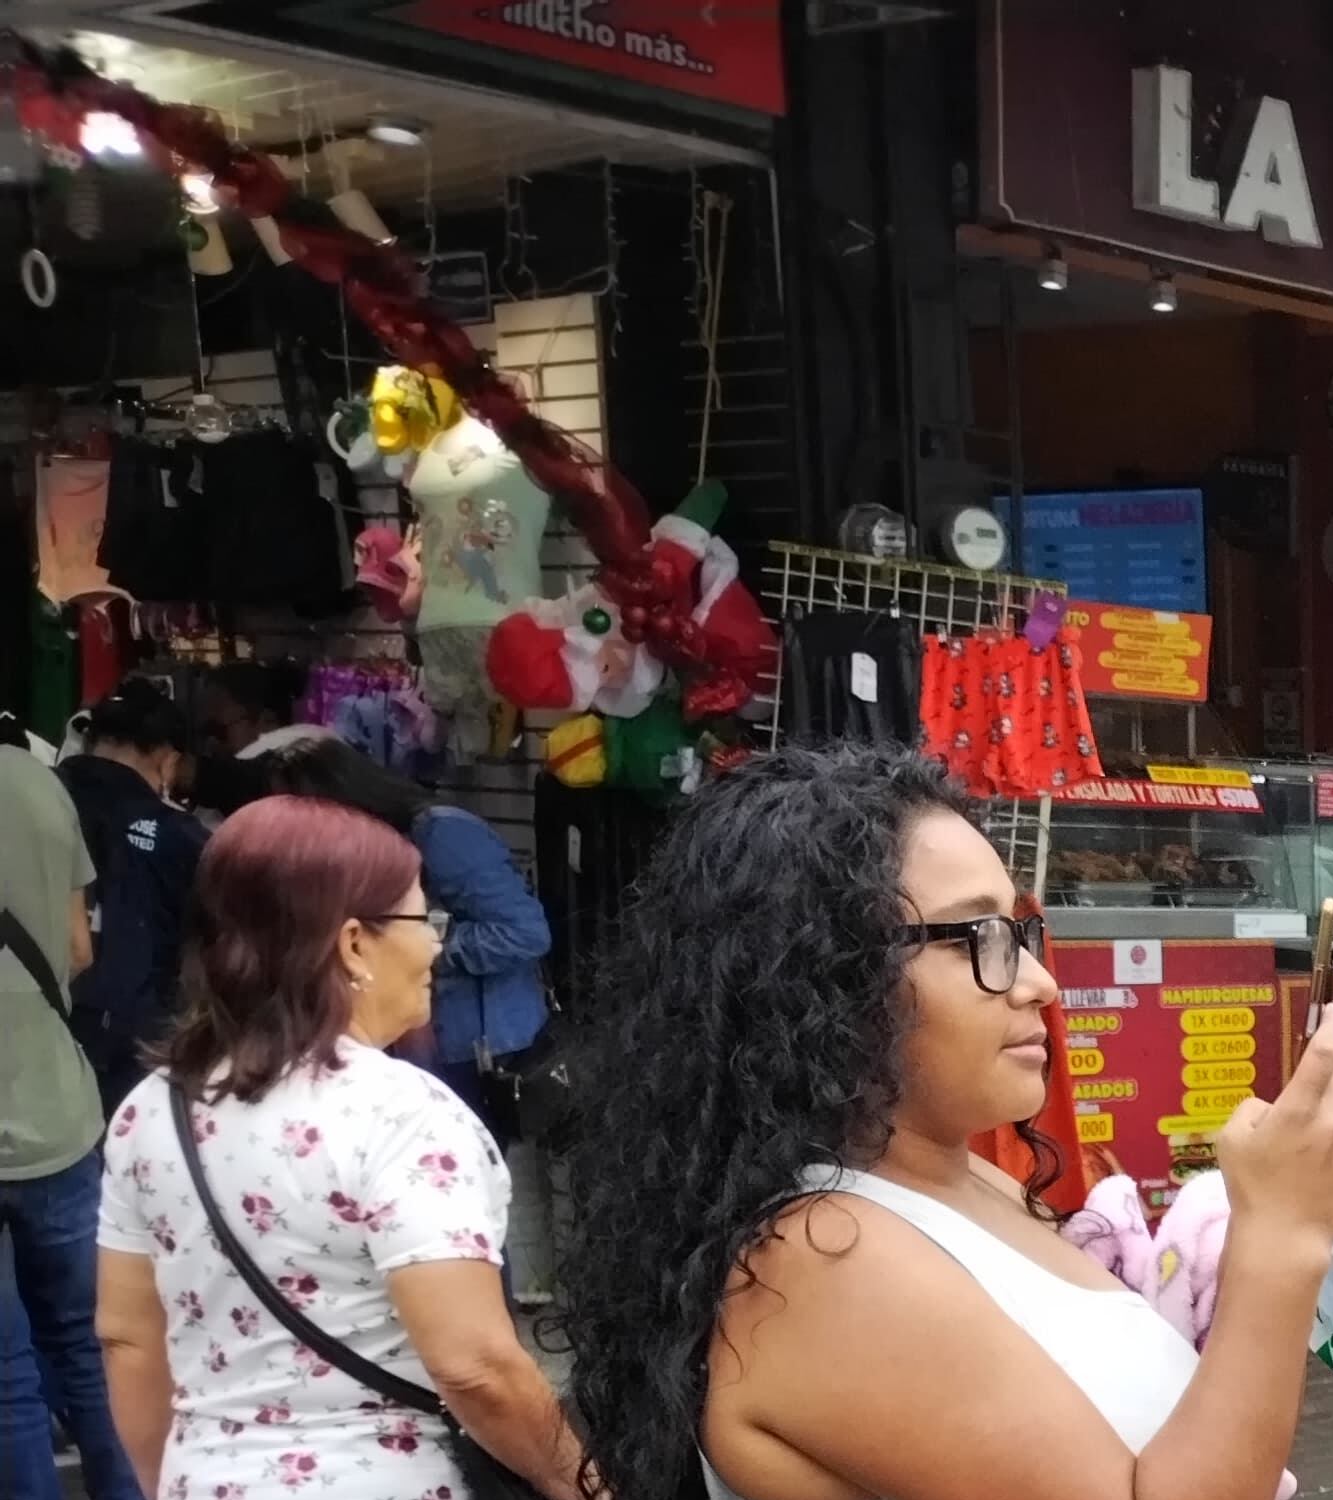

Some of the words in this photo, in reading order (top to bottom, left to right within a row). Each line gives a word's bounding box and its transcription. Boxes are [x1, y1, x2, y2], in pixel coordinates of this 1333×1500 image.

[1132, 63, 1323, 249] LA
[1146, 785, 1217, 806] TORTILLAS
[1161, 986, 1275, 1006] HAMBURGUESAS
